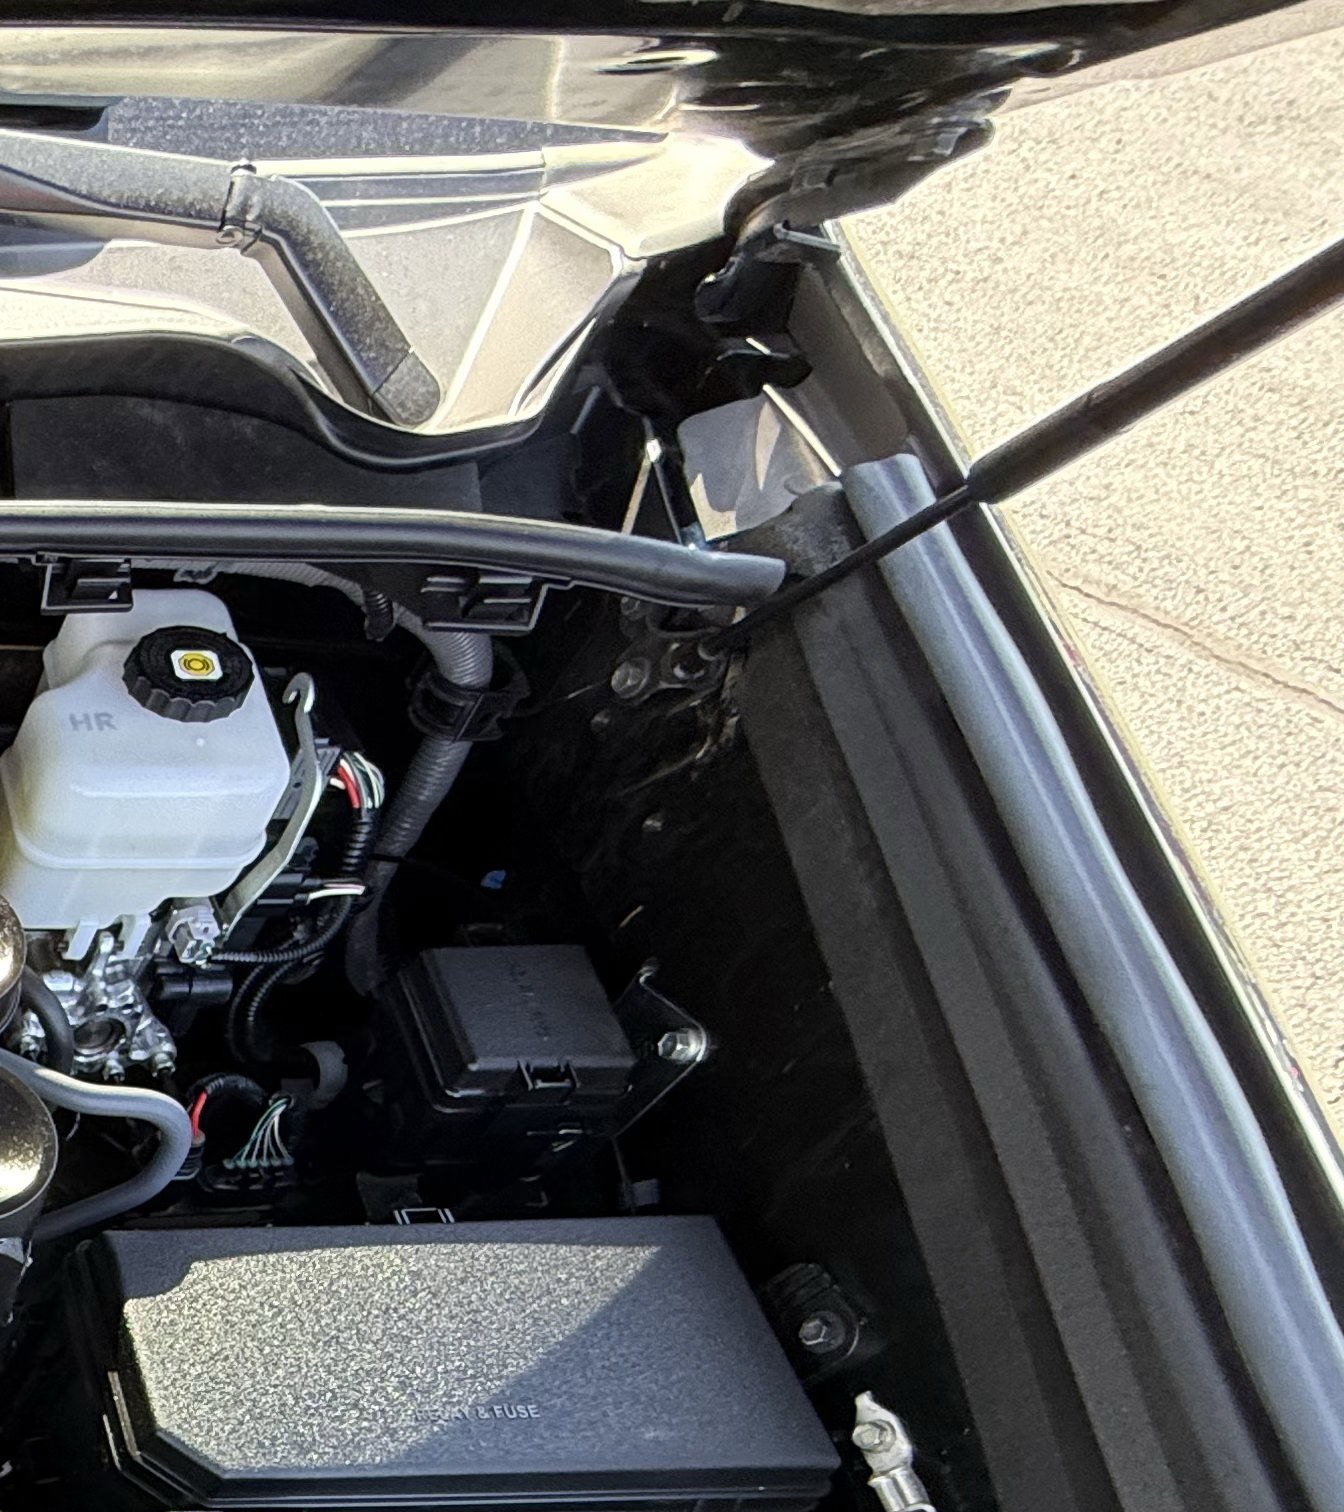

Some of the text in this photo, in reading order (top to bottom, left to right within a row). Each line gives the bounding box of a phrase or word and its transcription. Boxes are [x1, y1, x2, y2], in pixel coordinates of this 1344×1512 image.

[69, 712, 117, 732] HR
[476, 1405, 491, 1419] &
[492, 1403, 541, 1419] FUSE
